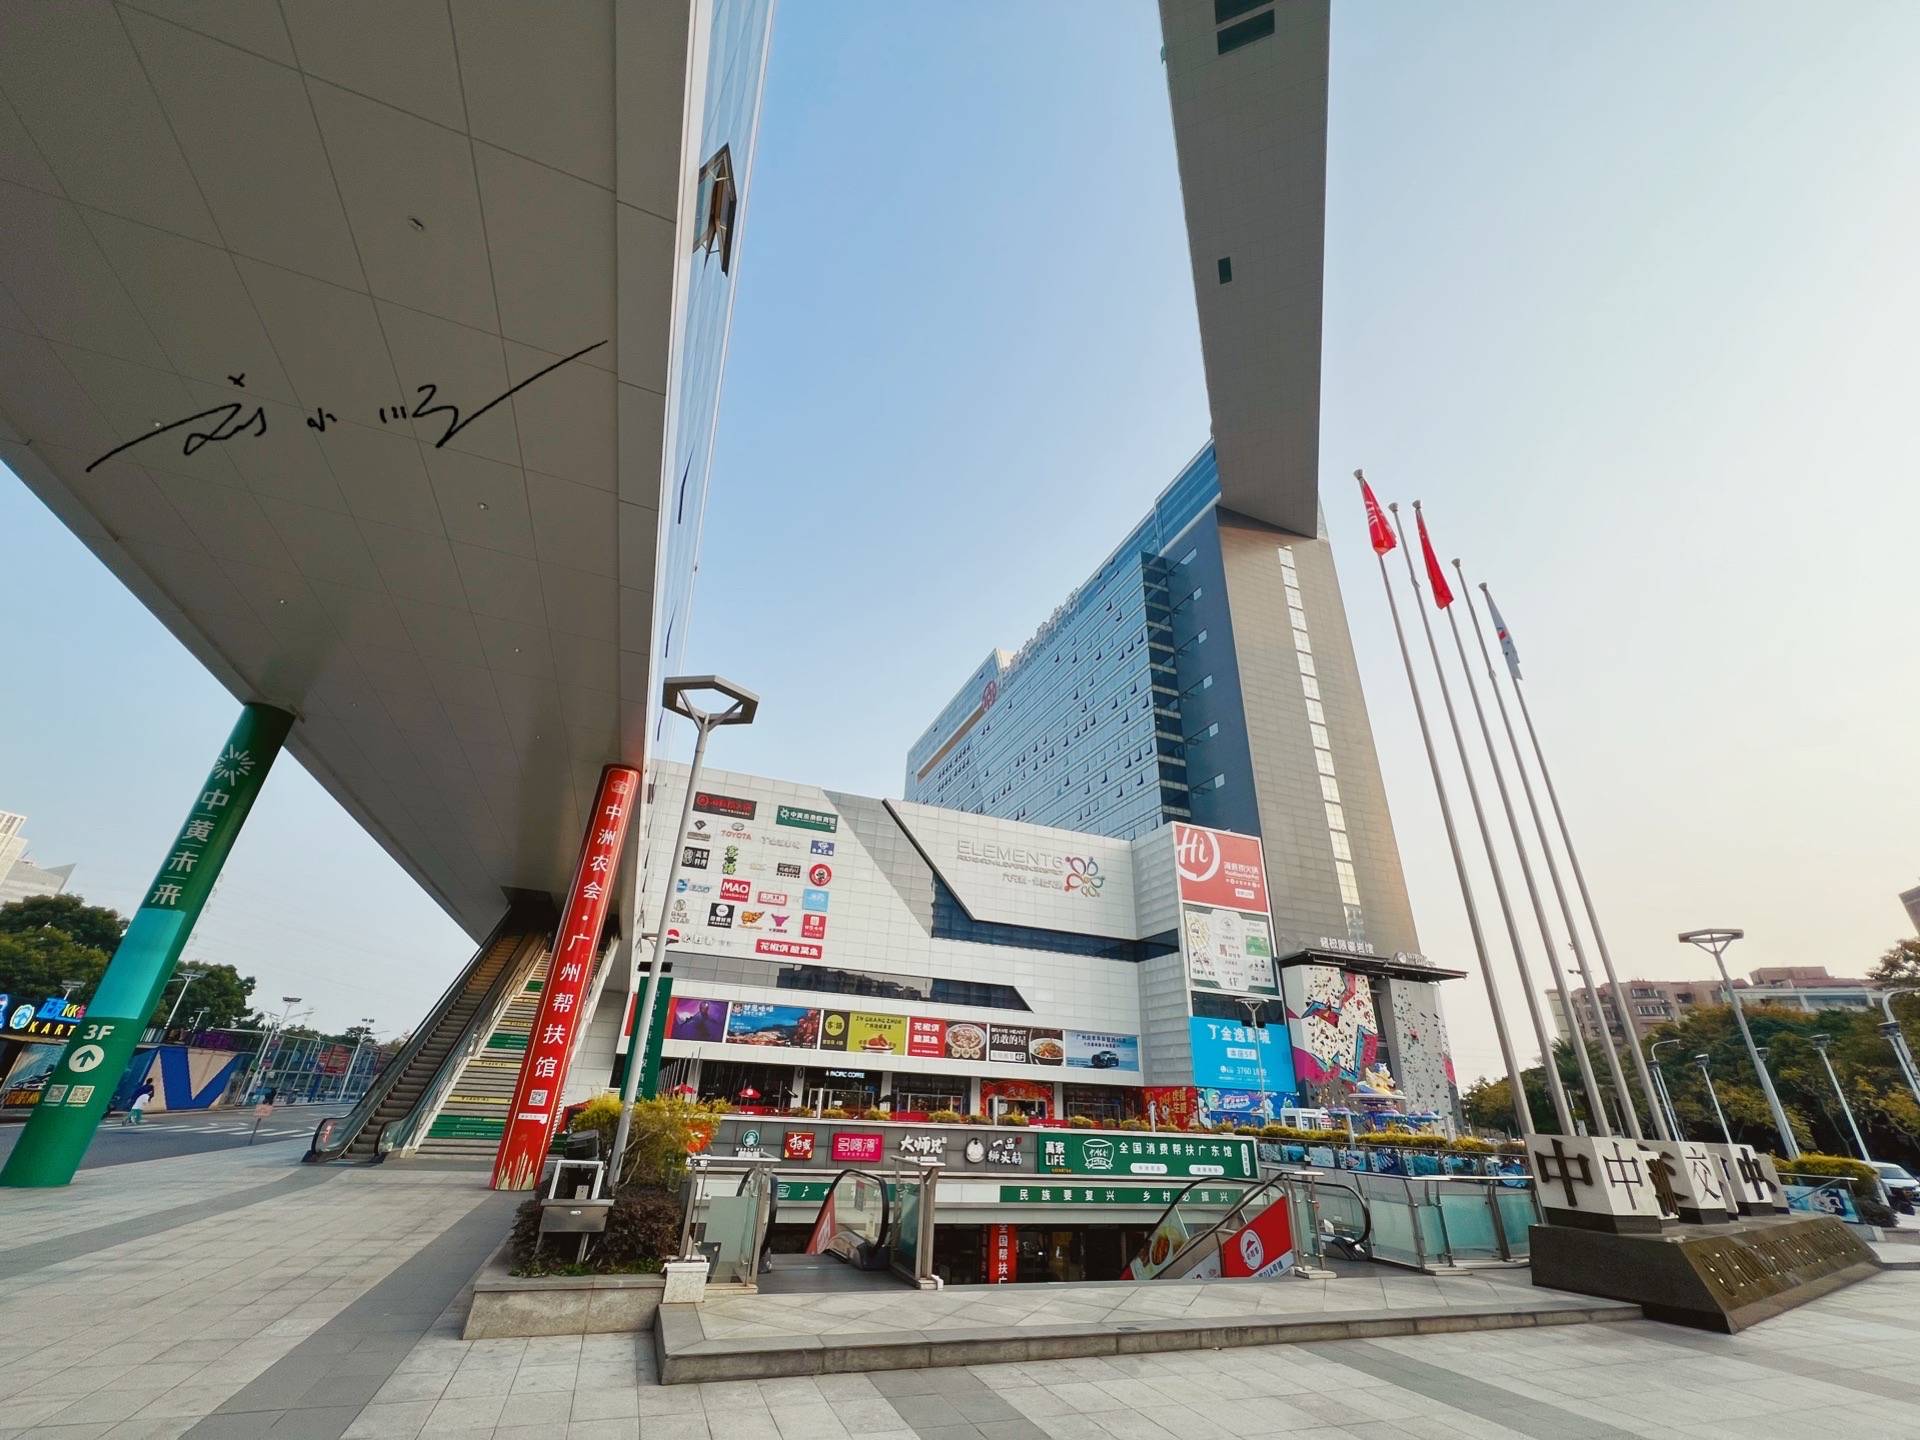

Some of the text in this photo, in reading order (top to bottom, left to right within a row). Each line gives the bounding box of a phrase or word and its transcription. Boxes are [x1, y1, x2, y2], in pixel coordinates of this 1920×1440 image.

[721, 830, 752, 841] TOYOTA
[150, 788, 230, 906] 中黄未来
[722, 881, 749, 894] MAO
[534, 804, 622, 1079] 中洲农会·广州帮扶馆
[27, 1021, 76, 1036] KART
[83, 1024, 115, 1040] 3F
[1119, 1141, 1233, 1158] 全国消费帮扶广东馆
[1019, 1188, 1116, 1201] 民族要复兴
